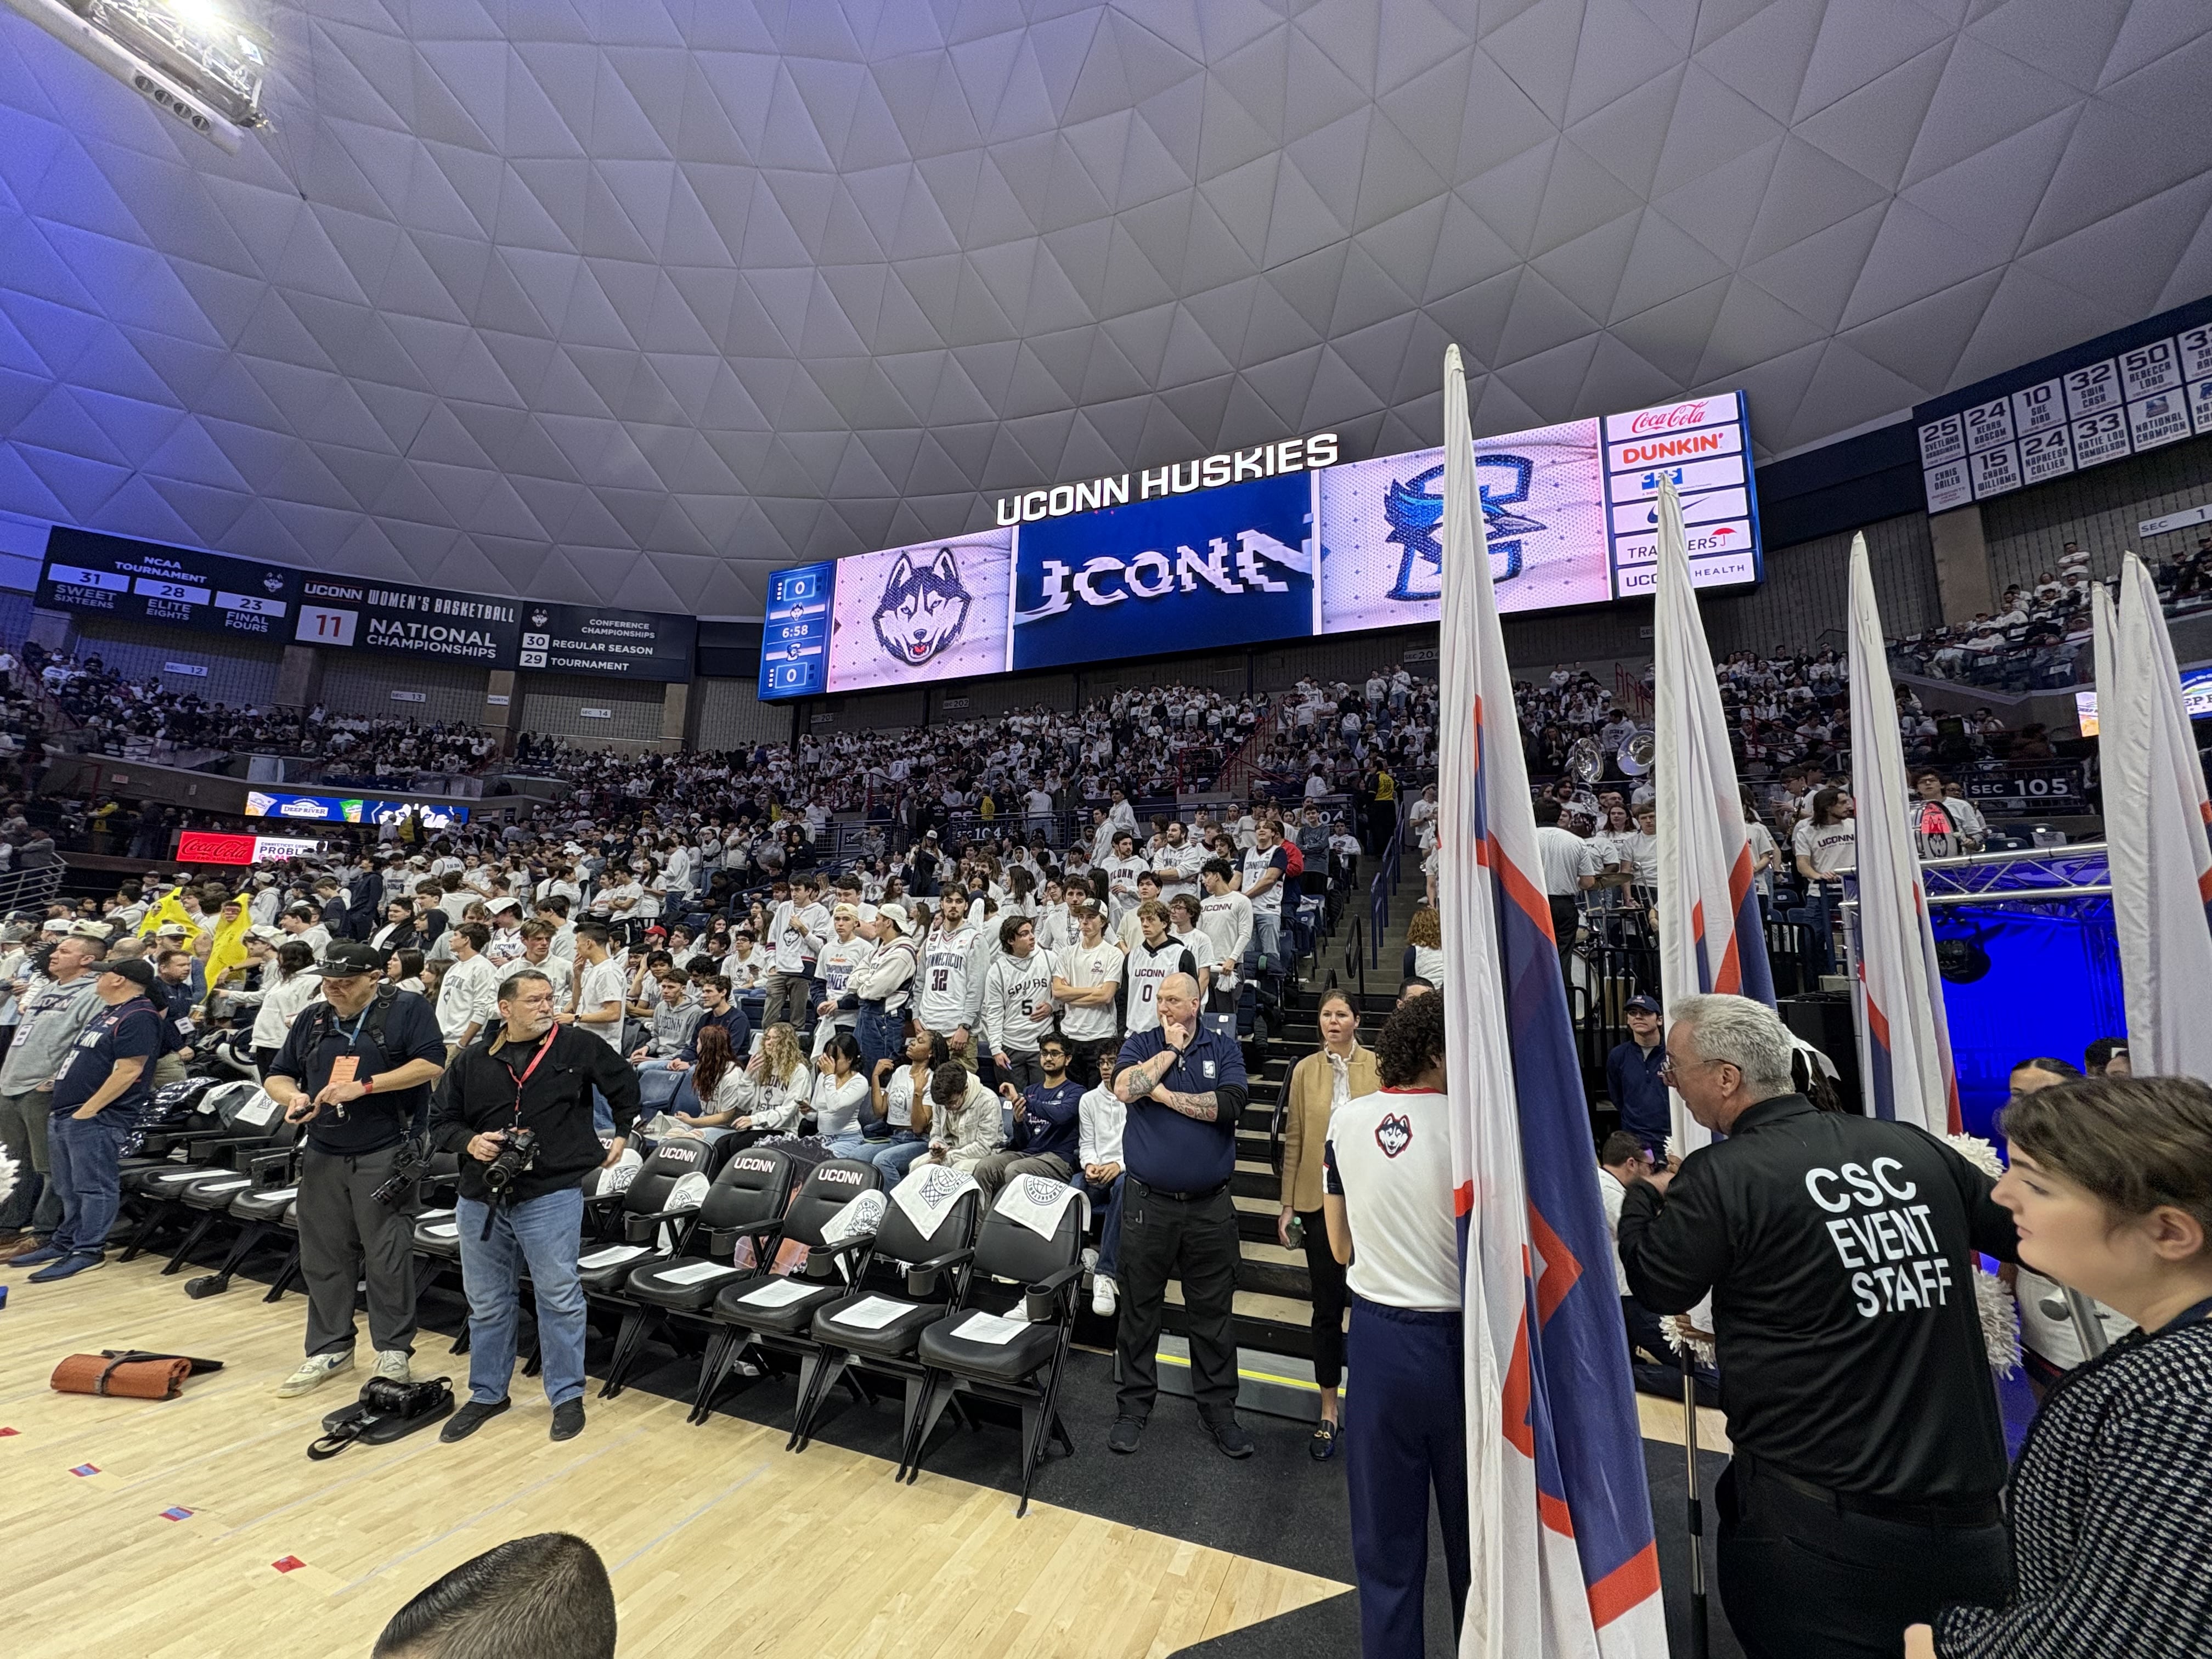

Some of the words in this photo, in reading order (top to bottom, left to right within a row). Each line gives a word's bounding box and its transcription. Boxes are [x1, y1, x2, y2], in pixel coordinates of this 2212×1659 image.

[2126, 343, 2169, 371] 50
[2069, 364, 2112, 391] 32
[2130, 361, 2171, 382] REBECCA
[2140, 374, 2164, 390] LOBO
[2023, 386, 2051, 408] 10
[2081, 384, 2104, 399] SWIN
[2032, 404, 2047, 416] SUE
[2083, 394, 2106, 409] CASH
[1632, 400, 1709, 433] Coca-Cola
[1968, 401, 2006, 427] 24
[2031, 413, 2050, 426] BIRD
[2136, 412, 2183, 433] NATIONAL
[1923, 419, 1958, 443] 25
[1977, 420, 2001, 435] KERRY
[2078, 413, 2120, 439] 33
[2136, 421, 2186, 443] CHAMPION
[1974, 427, 2006, 445] BASCOM
[2024, 430, 2064, 457] 24
[2078, 436, 2103, 451] KATIE
[2107, 430, 2125, 442] LOU
[1623, 432, 1723, 464] DUNKIN'
[2079, 439, 2126, 460] SAMUELSON
[1980, 449, 2008, 470] 15
[2025, 447, 2068, 467] NAPHEESA
[1935, 467, 1957, 481] CHRIS
[1983, 465, 2008, 481] GABBY
[2031, 458, 2065, 475] COLLIER
[996, 473, 1130, 526] UCONN
[1141, 432, 1338, 501] HUSKIES
[1934, 476, 1960, 490] DAILEY
[1977, 473, 2016, 491] WILLIAMS
[2141, 521, 2168, 532] SEC
[1627, 537, 1717, 558] TRAERS
[144, 556, 182, 569] NCAA
[1695, 564, 1745, 577] HEALTH
[80, 572, 101, 585] 31
[115, 561, 207, 583] TOURNAMENT
[56, 584, 117, 601] SWEET
[160, 585, 185, 598] 28
[795, 581, 805, 595] 0
[54, 594, 115, 609] SIXTEENS
[148, 598, 192, 613] ELITE
[239, 598, 263, 611] 23
[304, 583, 363, 600] UCONN
[368, 589, 429, 612] WOMEN'S
[434, 598, 515, 623] BASKETBALL
[146, 608, 189, 621] EIGHTS
[226, 611, 269, 625] FINAL
[225, 619, 268, 633] FOURS
[316, 614, 341, 637] 11
[369, 618, 497, 647] NATIONAL
[581, 627, 655, 639] CHAMPIONSHIPS
[589, 619, 650, 630] CONFERENCE
[782, 625, 809, 638] 6:58
[366, 634, 496, 659] CHAMPIONSHIPS
[527, 636, 546, 646] 30
[552, 639, 606, 652] REGULAR
[608, 644, 653, 656] SEASON
[191, 667, 203, 675] 12
[524, 654, 543, 664] 29
[550, 658, 630, 671] TOURNAMENT
[786, 668, 797, 682] 0
[953, 699, 969, 707] 202
[1972, 785, 2004, 794] SEC
[2014, 778, 2068, 795] 105
[1318, 810, 1345, 824] 04
[182, 838, 252, 857] Coca-Cola
[1817, 833, 1855, 848] UCONN
[259, 846, 303, 855] PROBL
[931, 969, 949, 991] 32
[1135, 969, 1165, 977] UCONN
[1008, 978, 1047, 997] SPURS
[1142, 984, 1152, 1002] 0
[1022, 1000, 1032, 1015] 5
[658, 1015, 683, 1031] UCONN
[659, 1147, 697, 1163] UCONN
[733, 1157, 776, 1173] UCONN
[818, 1168, 863, 1186] UCONN
[1805, 1157, 1916, 1213] CSC
[1825, 1205, 1939, 1268] EVENT
[1851, 1259, 1952, 1317] STAFF
